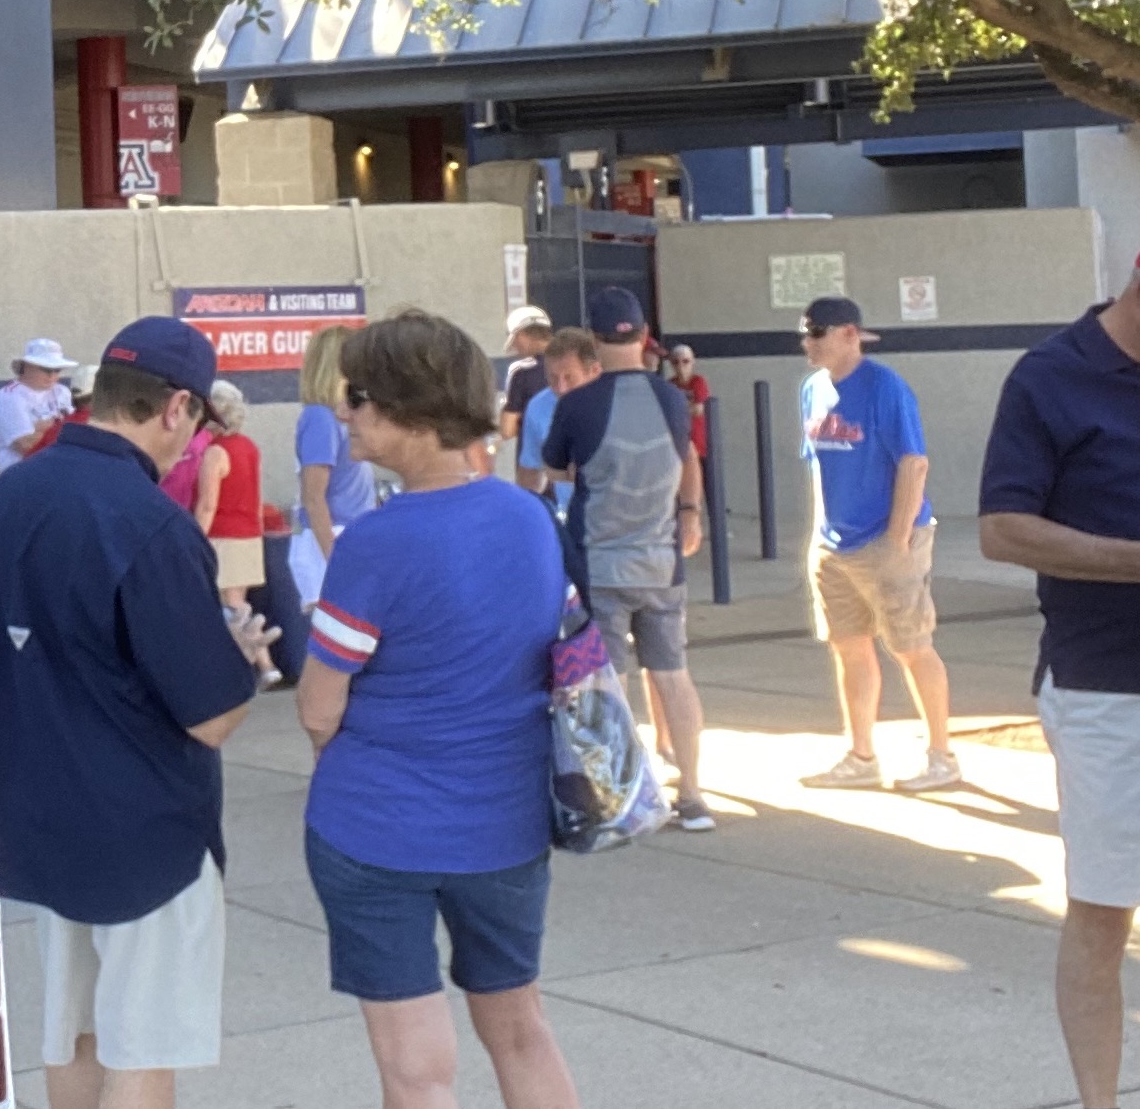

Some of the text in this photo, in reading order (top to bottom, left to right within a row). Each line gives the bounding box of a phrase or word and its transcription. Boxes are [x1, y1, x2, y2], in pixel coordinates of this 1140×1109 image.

[147, 115, 175, 128] K-N
[119, 140, 160, 194] A
[269, 294, 279, 311] &
[280, 294, 325, 311] VISITING
[327, 293, 357, 310] TEAM
[205, 331, 268, 356] AYER
